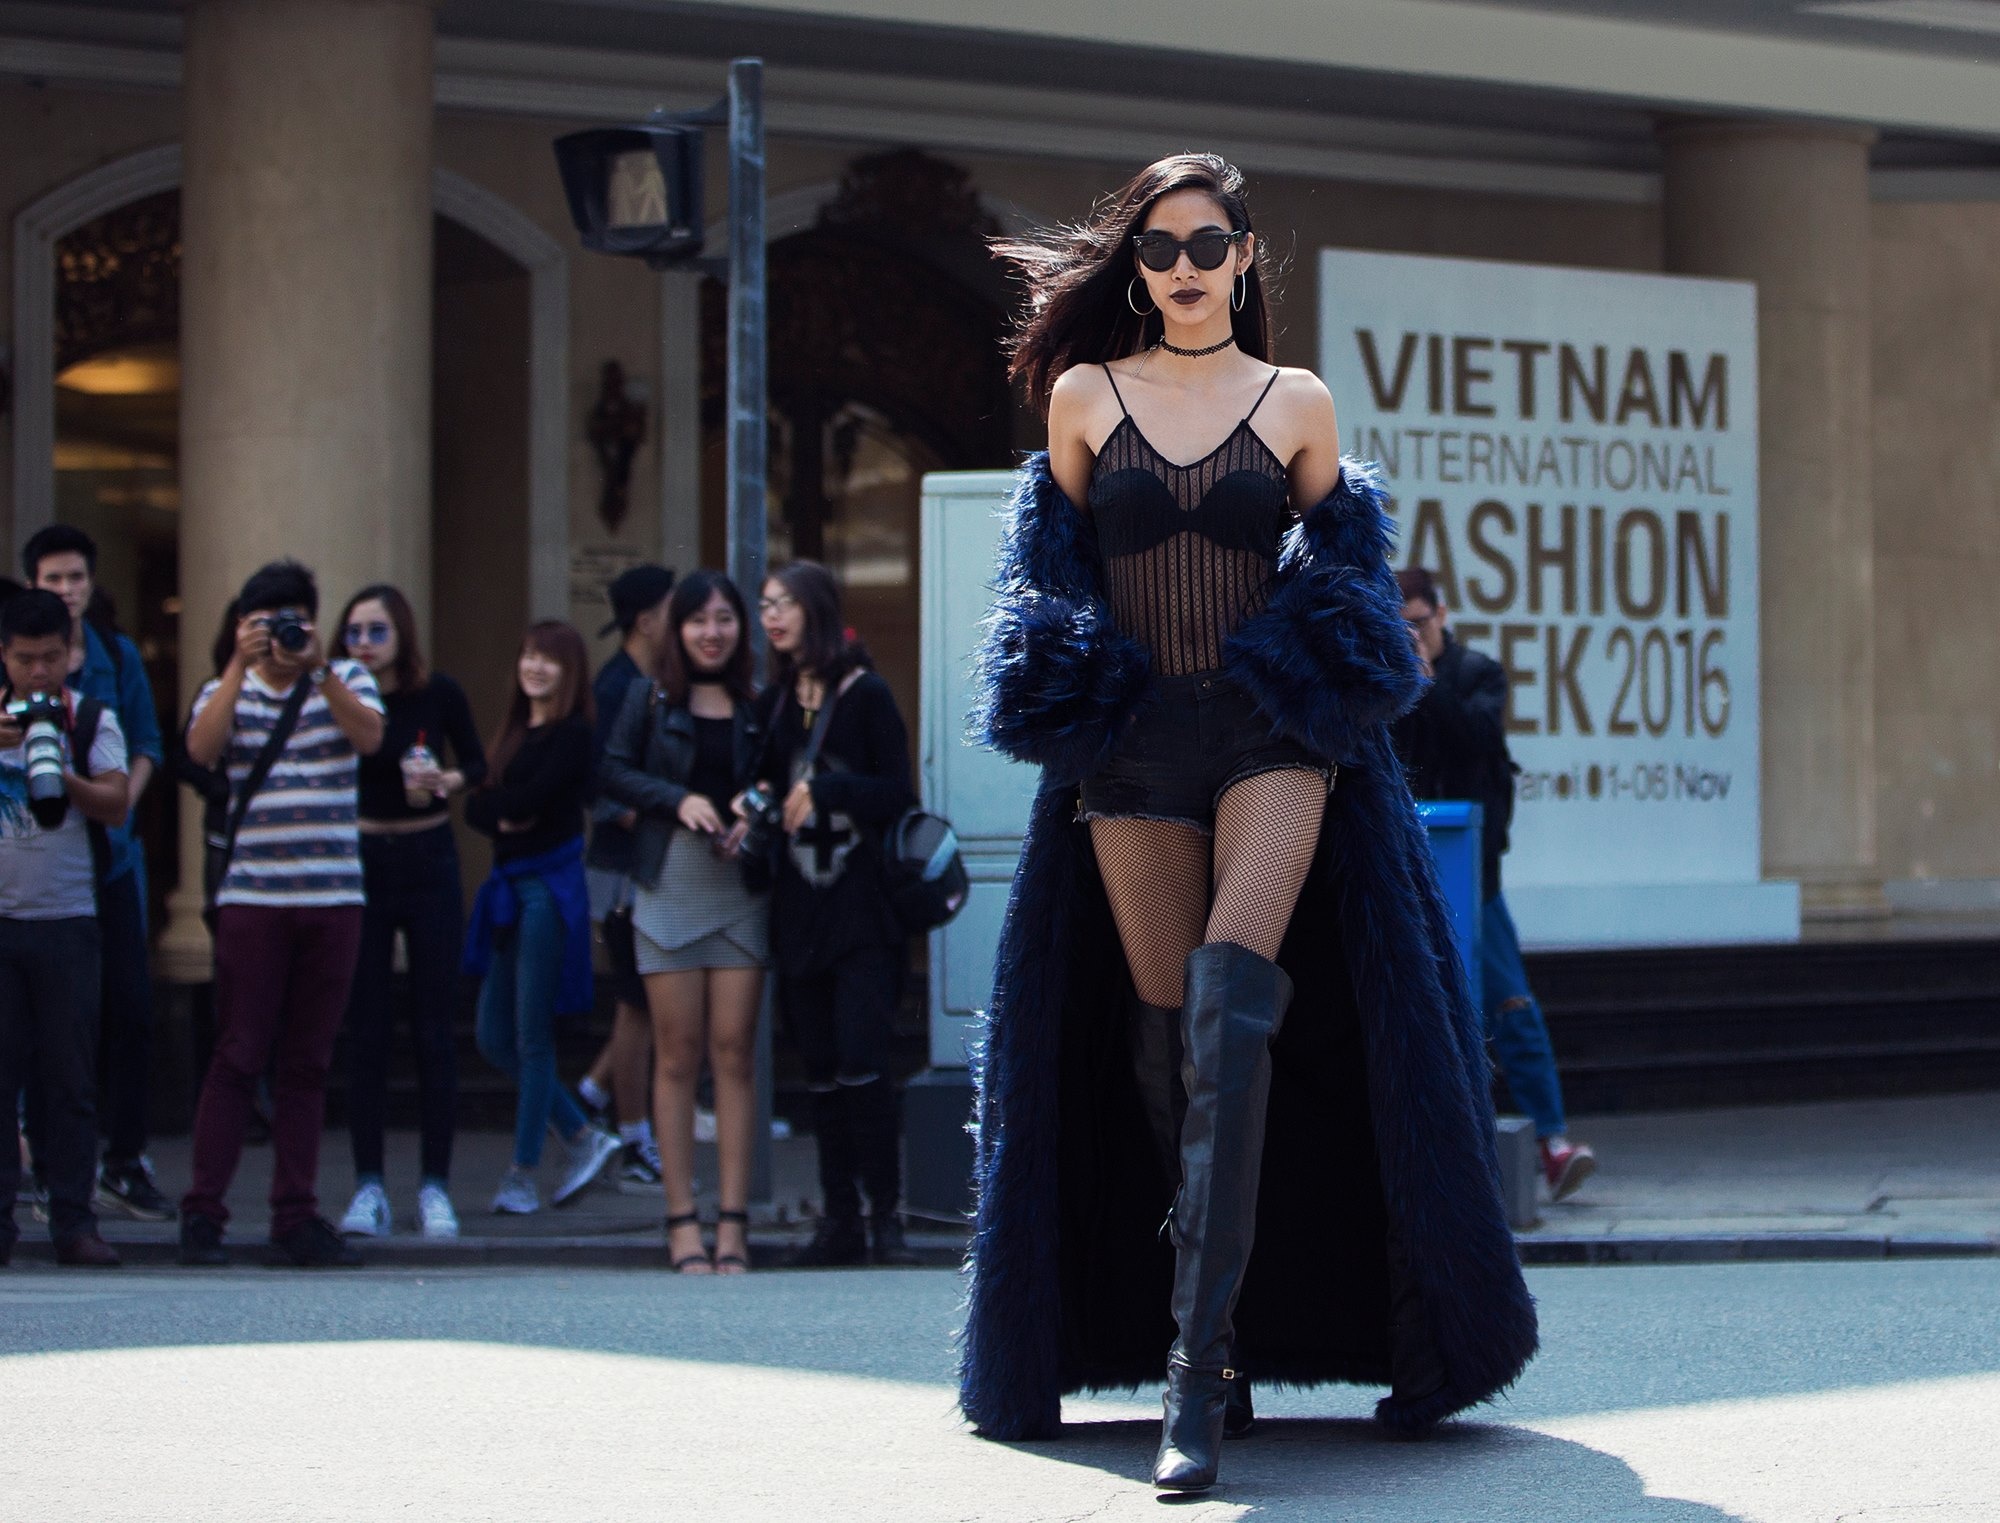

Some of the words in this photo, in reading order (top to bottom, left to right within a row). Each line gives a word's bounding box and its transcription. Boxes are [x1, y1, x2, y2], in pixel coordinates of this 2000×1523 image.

[1354, 327, 1730, 432] VIETNAM
[1354, 426, 1731, 496] INTERNATIONAL
[1382, 496, 1730, 621] ASHION
[1455, 621, 1594, 737] EK
[1605, 625, 1731, 739] 2016
[1673, 762, 1732, 802] Nov
